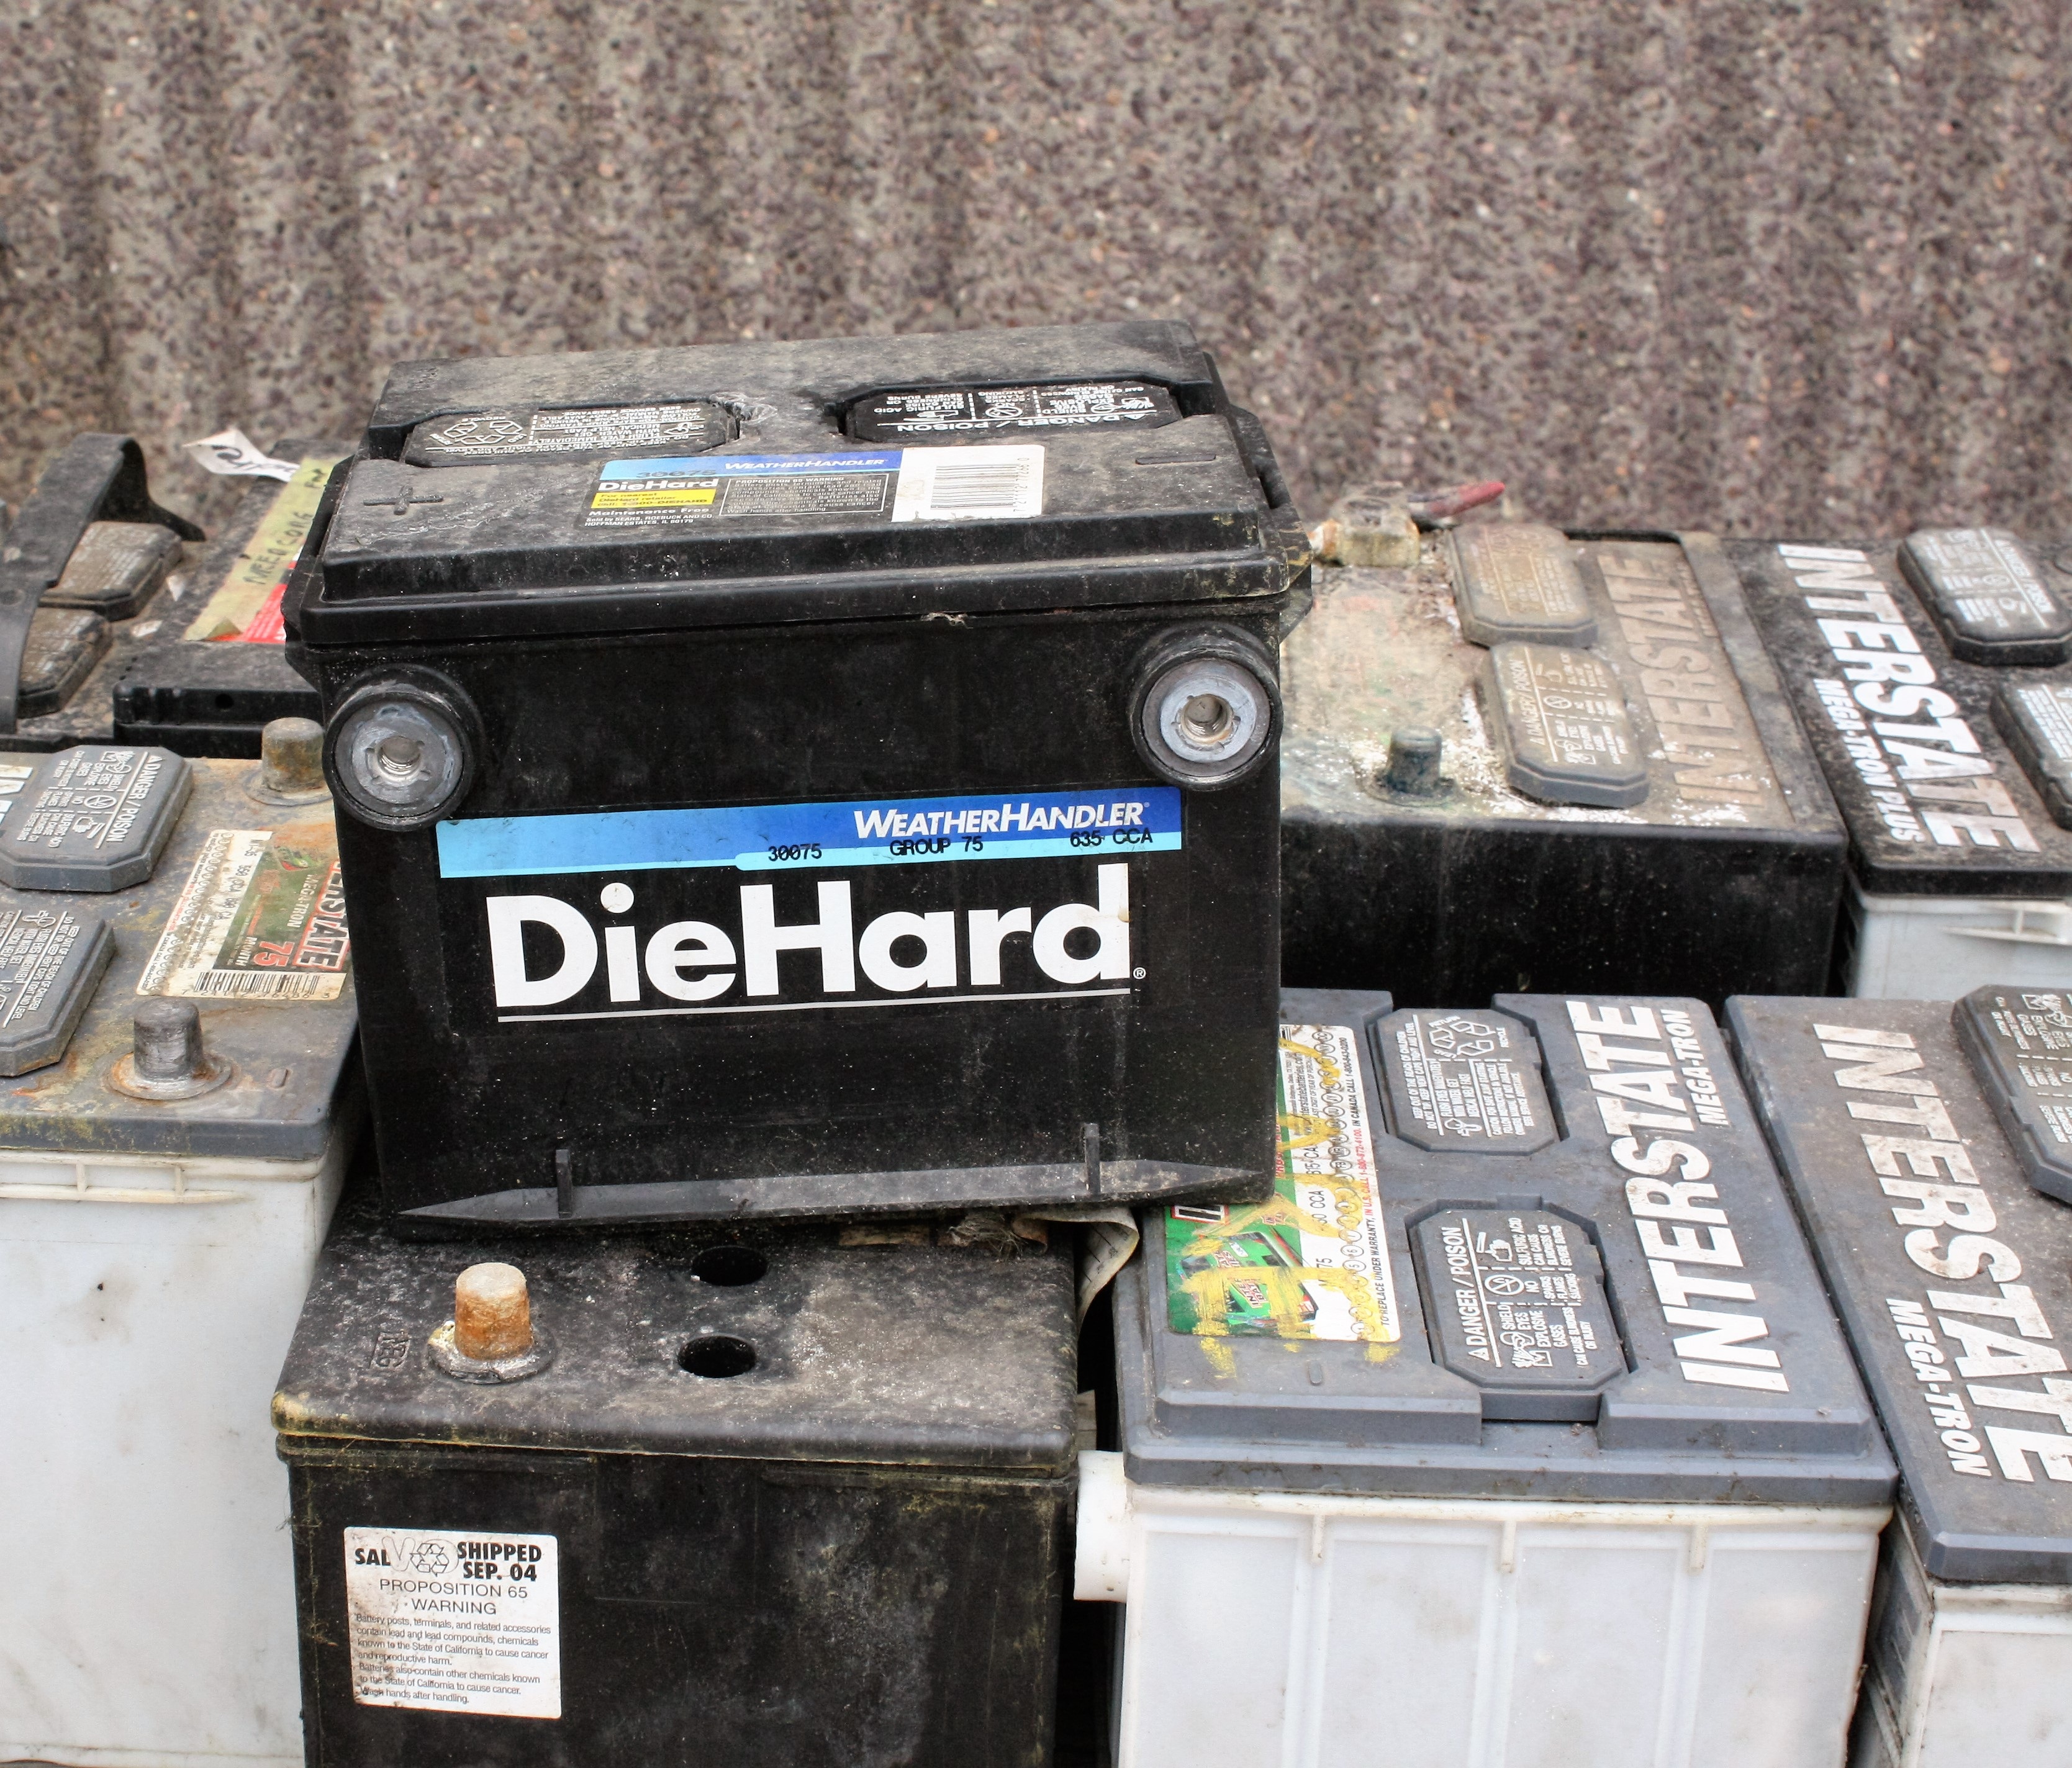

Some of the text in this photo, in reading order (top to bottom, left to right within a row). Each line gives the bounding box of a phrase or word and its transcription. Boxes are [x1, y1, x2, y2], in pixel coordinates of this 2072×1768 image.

[897, 415, 1121, 431] DANGER POISON
[725, 458, 887, 470] WEATHERHANDLER
[598, 479, 718, 490] DieHard
[588, 508, 676, 516] Maintenance
[1598, 556, 1762, 805] INTERSTATE
[1778, 544, 2040, 852] INTERSTATE
[1813, 678, 1927, 843] MEGA-TRON PLUS
[105, 763, 162, 842] DANGER POISON
[854, 803, 1144, 839] WEATHERHANDLER
[768, 829, 1153, 862] 30075 GROUP 75 635 CCA
[286, 874, 321, 927] MEGA-TRON
[486, 863, 1131, 1007] DieHard
[233, 936, 258, 966] MONTH
[249, 940, 296, 967] 75
[1660, 1009, 1731, 1127] MEGA-TRON
[1346, 1078, 1355, 1092] CALL
[1348, 1094, 1359, 1118] CANADA
[1359, 1178, 1370, 1193] CALL
[1566, 1000, 1789, 1392] INTERSTATE
[1362, 1194, 1372, 1206] U.S.
[1365, 1217, 1380, 1255] WARRANTY,
[1507, 1217, 1533, 1265] SULFURIC ACID
[1441, 1227, 1471, 1274] POISON
[1527, 1234, 1545, 1265] CAN CAUSE
[1813, 1024, 2072, 1484] INTERSTATE
[1370, 1257, 1383, 1280] UNDER
[1524, 1281, 1540, 1292] NO
[1375, 1283, 1387, 1314] REPLACE
[1380, 1315, 1389, 1325] TO
[1454, 1289, 1488, 1345] DANGER
[1496, 1304, 1516, 1329] SHIELD
[1513, 1312, 1531, 1330] EYES
[1528, 1310, 1551, 1346] EXPLOSIVE
[1548, 1324, 1568, 1346] GASES
[1886, 1297, 1992, 1478] MEGA-TRON
[457, 1541, 542, 1562] SHIPPED
[463, 1561, 537, 1581] SEP. 04
[379, 1578, 528, 1599] PROPOSITION 65
[411, 1598, 497, 1615] WARNING
[356, 1613, 551, 1635] Battery posts, terminals, and related accessories
[356, 1626, 539, 1646] contain lead and lead compounds, chemicals
[357, 1638, 549, 1660] known to the State of California to cause cancer
[358, 1651, 452, 1666] and reproductive harm.
[358, 1662, 540, 1684] Batteries also contain other chemicals known
[360, 1674, 521, 1695] to the State of California to cause cancer.
[386, 1688, 410, 1698] hands
[412, 1690, 431, 1700] after
[432, 1691, 469, 1705] handling.
